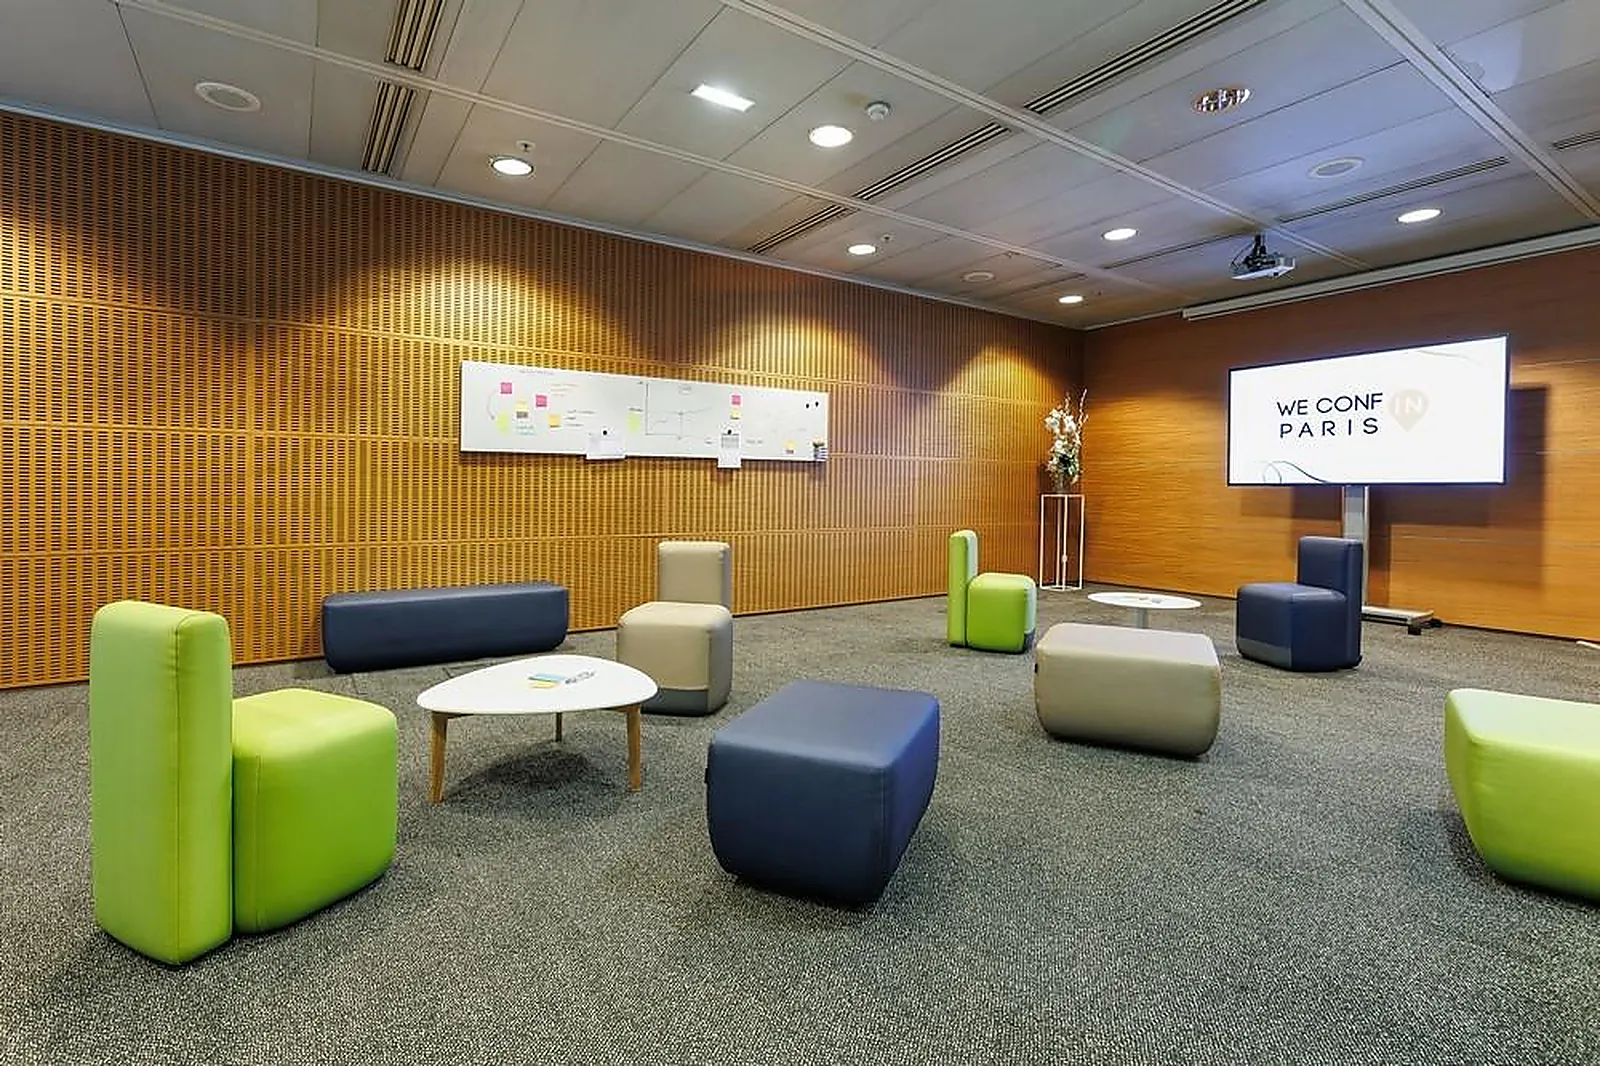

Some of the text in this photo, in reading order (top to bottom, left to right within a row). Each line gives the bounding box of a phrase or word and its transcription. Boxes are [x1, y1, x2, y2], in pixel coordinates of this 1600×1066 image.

[1276, 392, 1423, 416] WE CONF IN
[1280, 417, 1379, 439] PARIS
